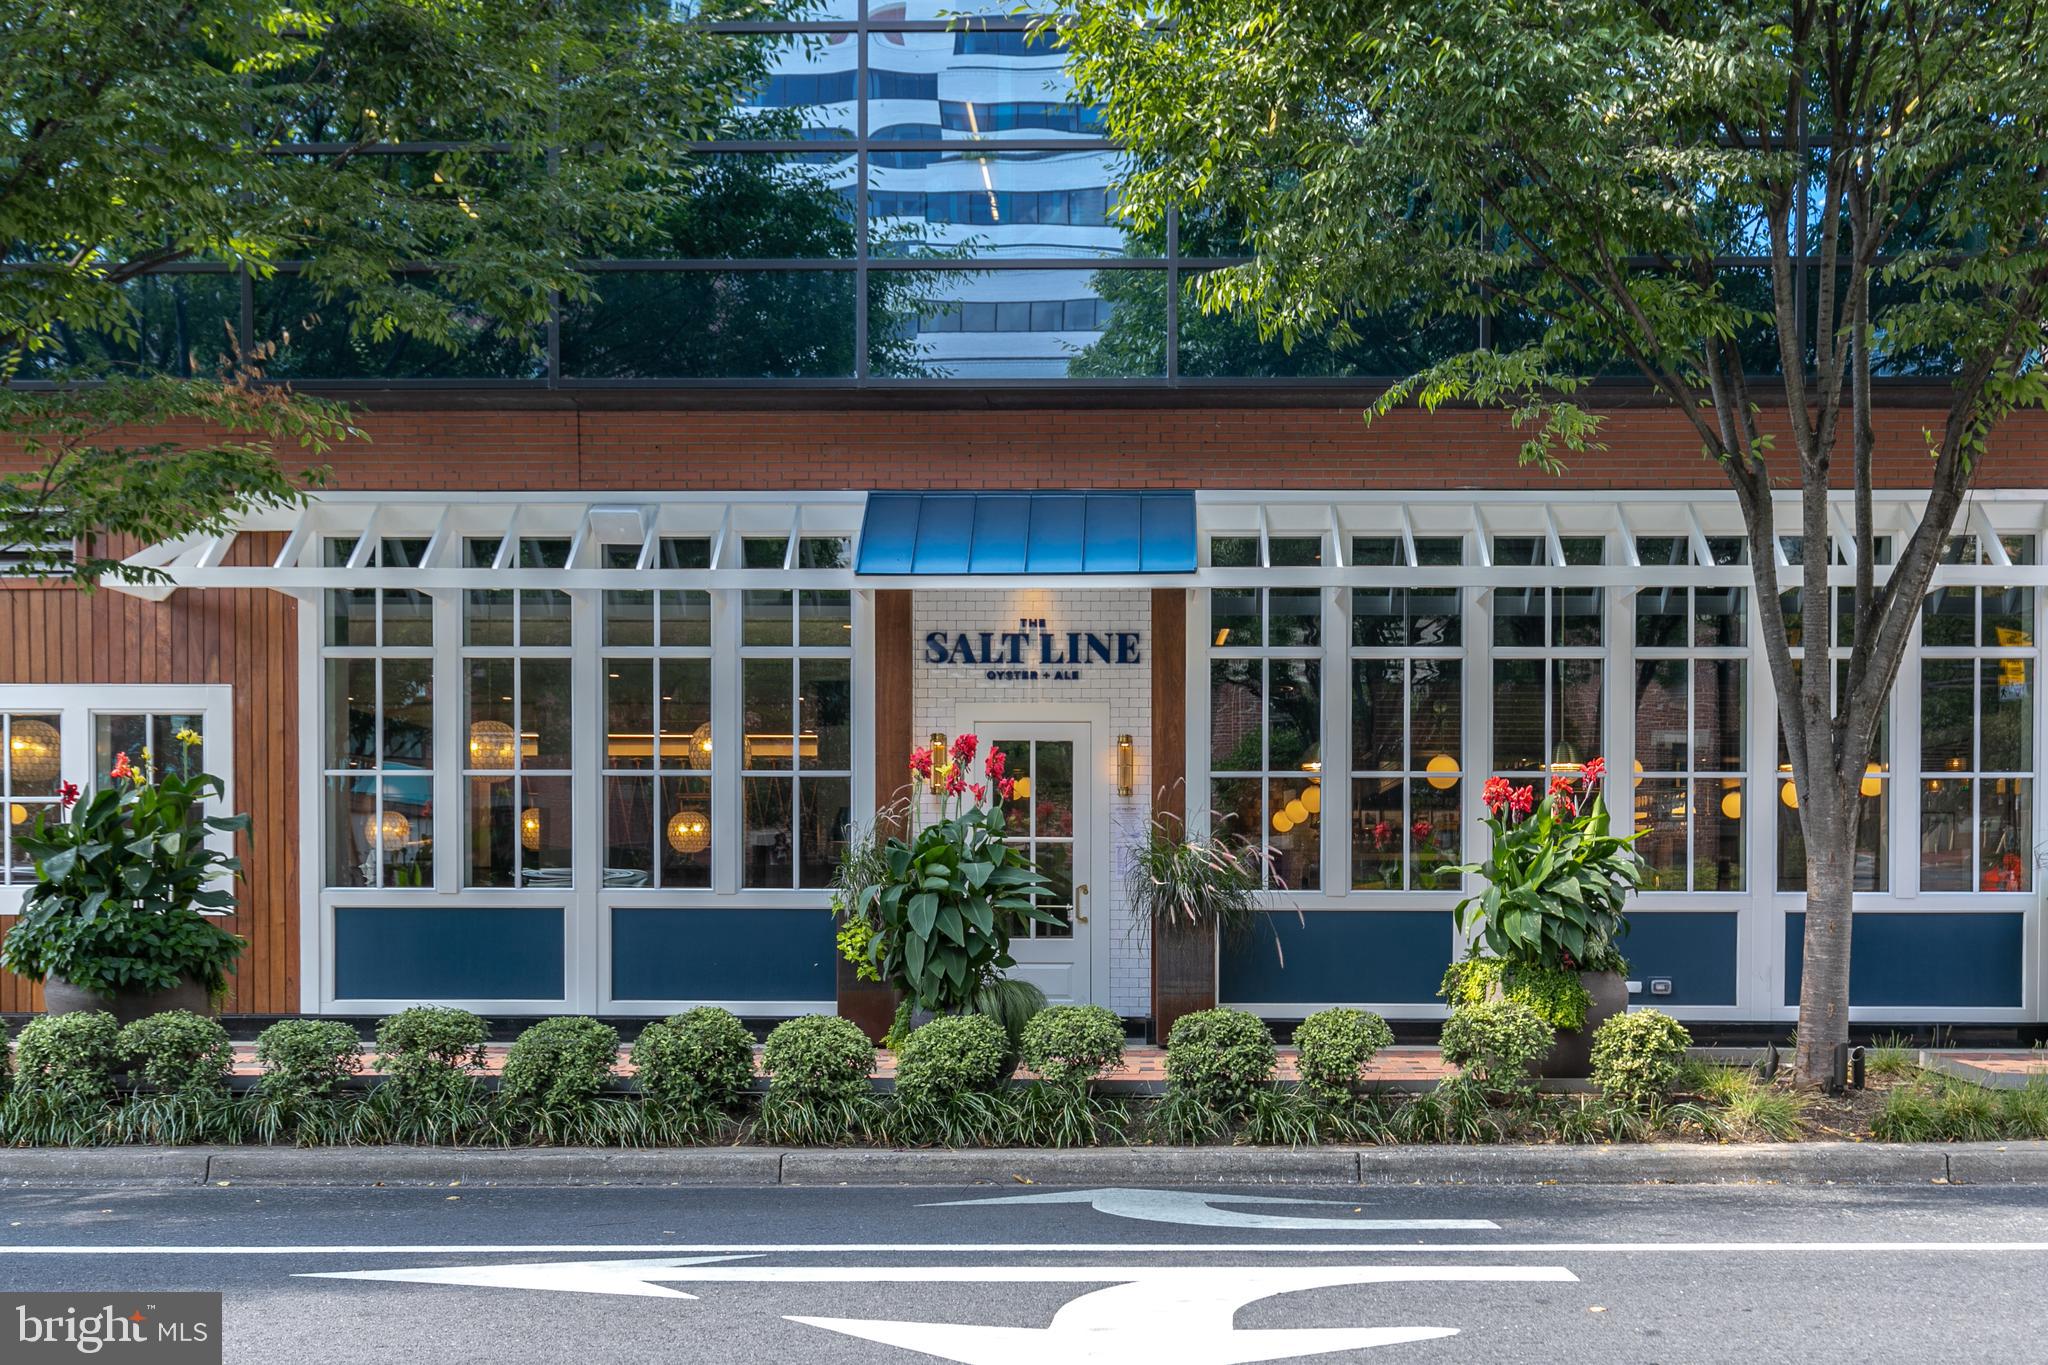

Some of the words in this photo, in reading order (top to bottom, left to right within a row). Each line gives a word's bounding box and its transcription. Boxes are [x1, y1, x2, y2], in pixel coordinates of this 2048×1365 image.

[1020, 618, 1046, 628] THE
[925, 631, 1030, 664] SALT
[1039, 632, 1141, 664] LINE
[986, 671, 1039, 680] OYSTER
[1054, 671, 1079, 680] ALE
